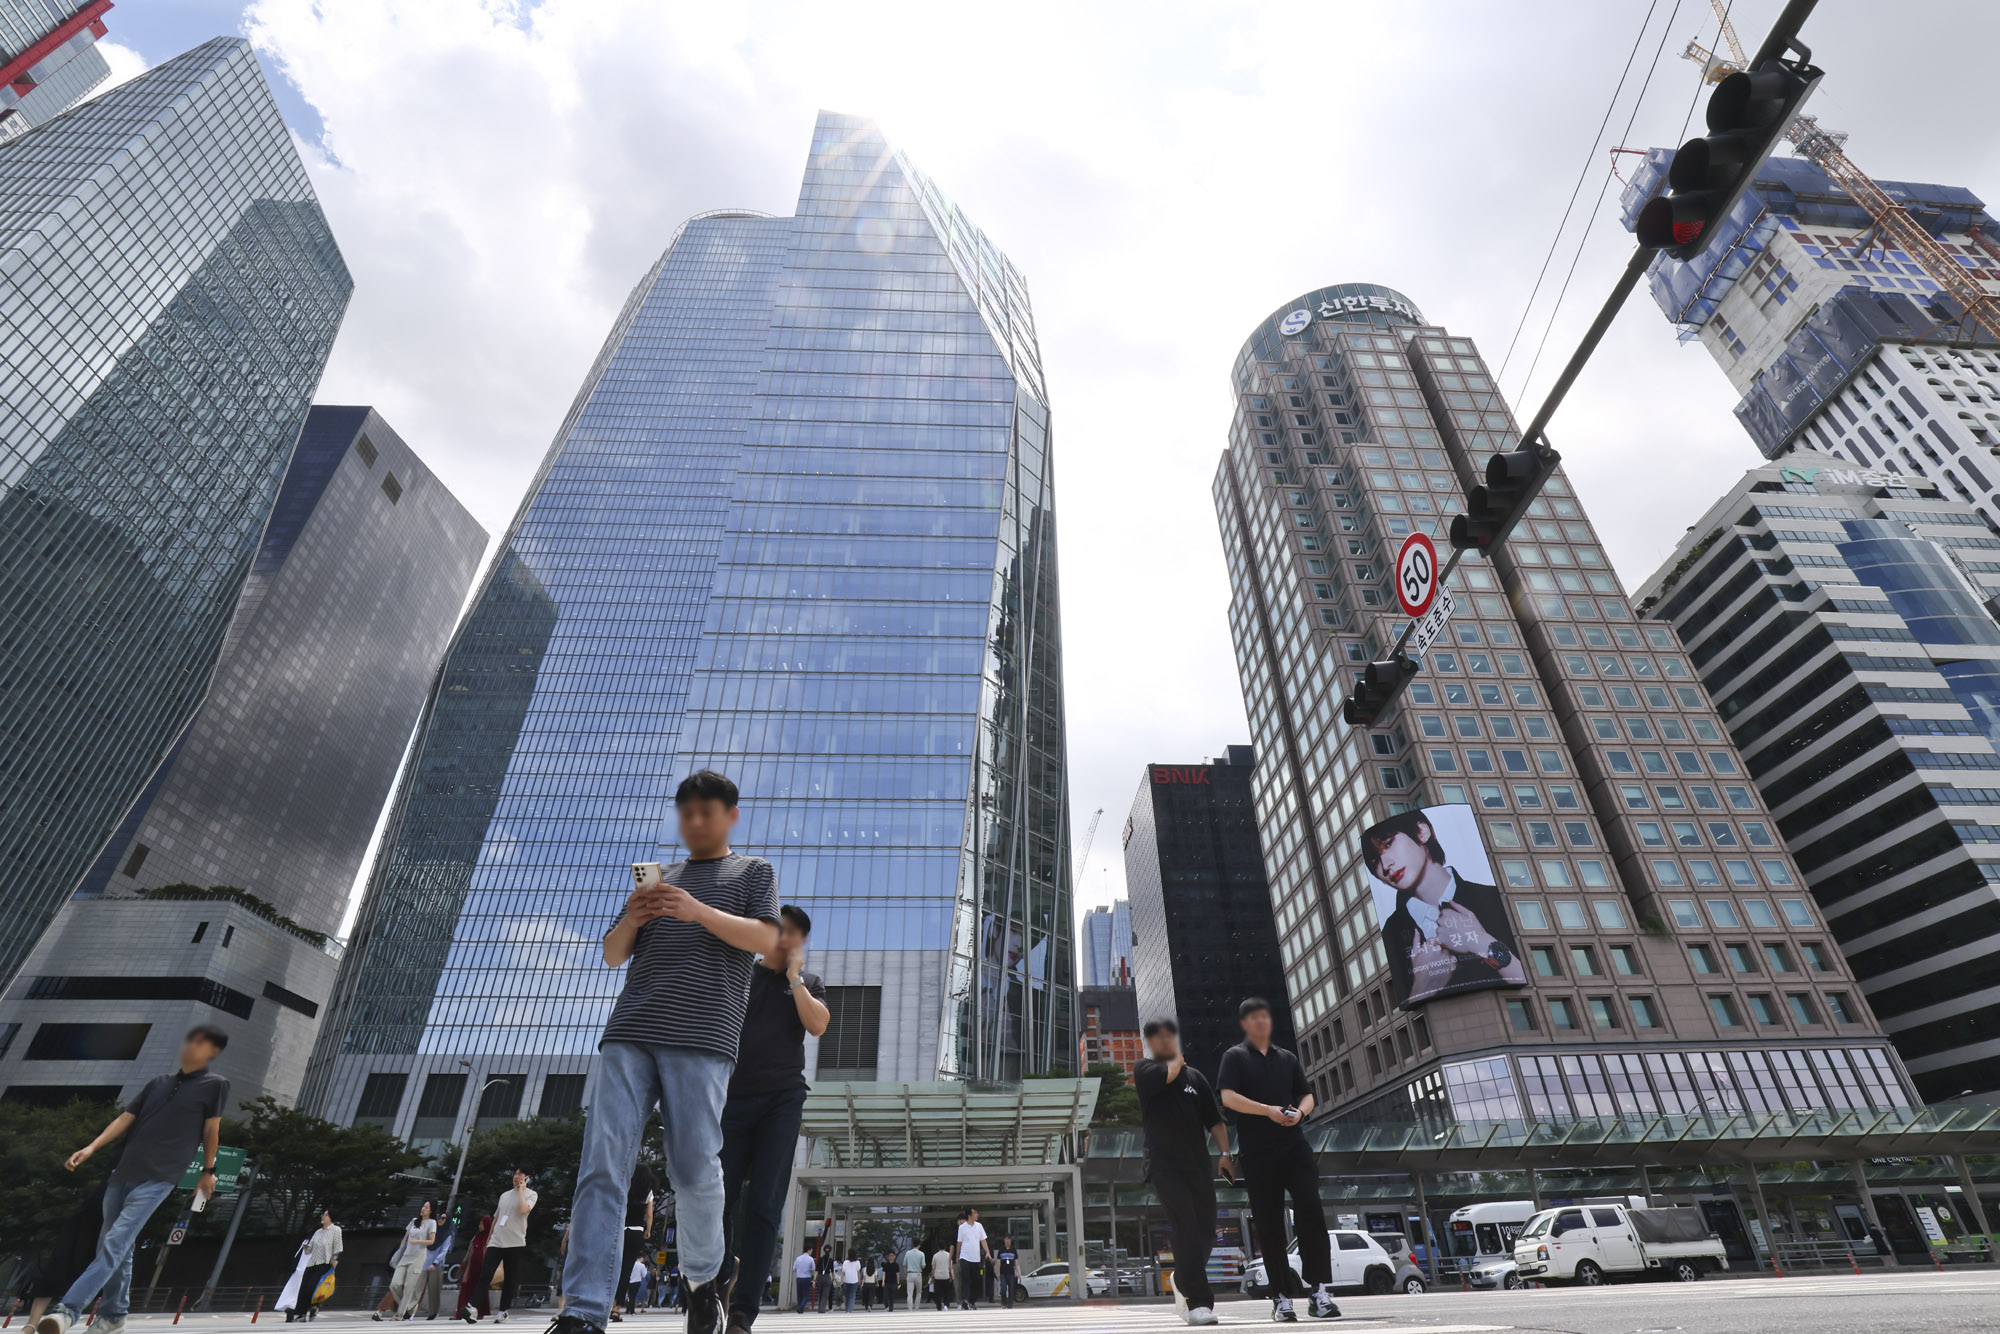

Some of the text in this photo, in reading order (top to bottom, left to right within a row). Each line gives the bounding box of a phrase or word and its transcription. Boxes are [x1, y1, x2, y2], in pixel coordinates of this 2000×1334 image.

[1834, 373, 1843, 381] 13
[1809, 399, 1818, 408] 12
[1824, 468, 1908, 488] iM증권
[1403, 550, 1429, 601] 50
[1417, 596, 1451, 649] 속도준수
[1153, 768, 1211, 784] BNK
[1449, 930, 1479, 948] 갖자
[1429, 957, 1457, 968] Watch8
[1429, 967, 1450, 976] Galaxy
